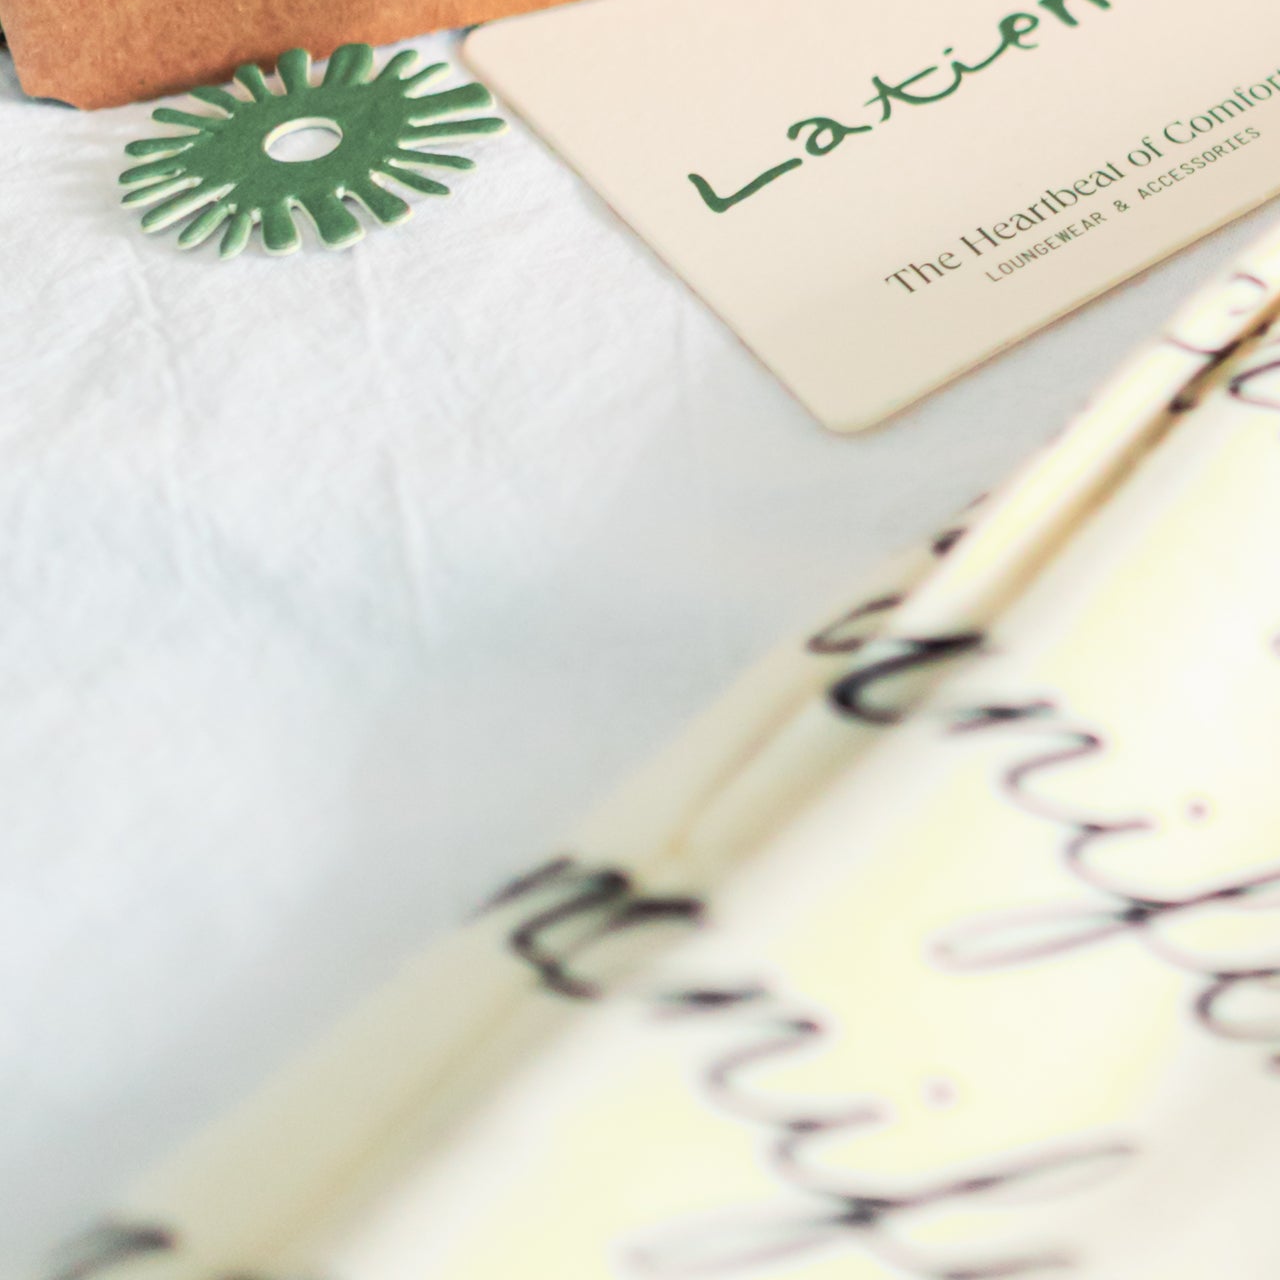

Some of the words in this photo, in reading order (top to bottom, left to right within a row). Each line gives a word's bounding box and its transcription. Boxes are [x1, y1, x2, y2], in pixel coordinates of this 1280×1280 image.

[884, 250, 964, 295] The
[959, 161, 1126, 258] Heartbeat
[1126, 136, 1165, 169] of
[984, 210, 1109, 284] LOUNGEWEAR
[1113, 198, 1131, 214] &
[1136, 126, 1263, 202] ACCESSORIES
